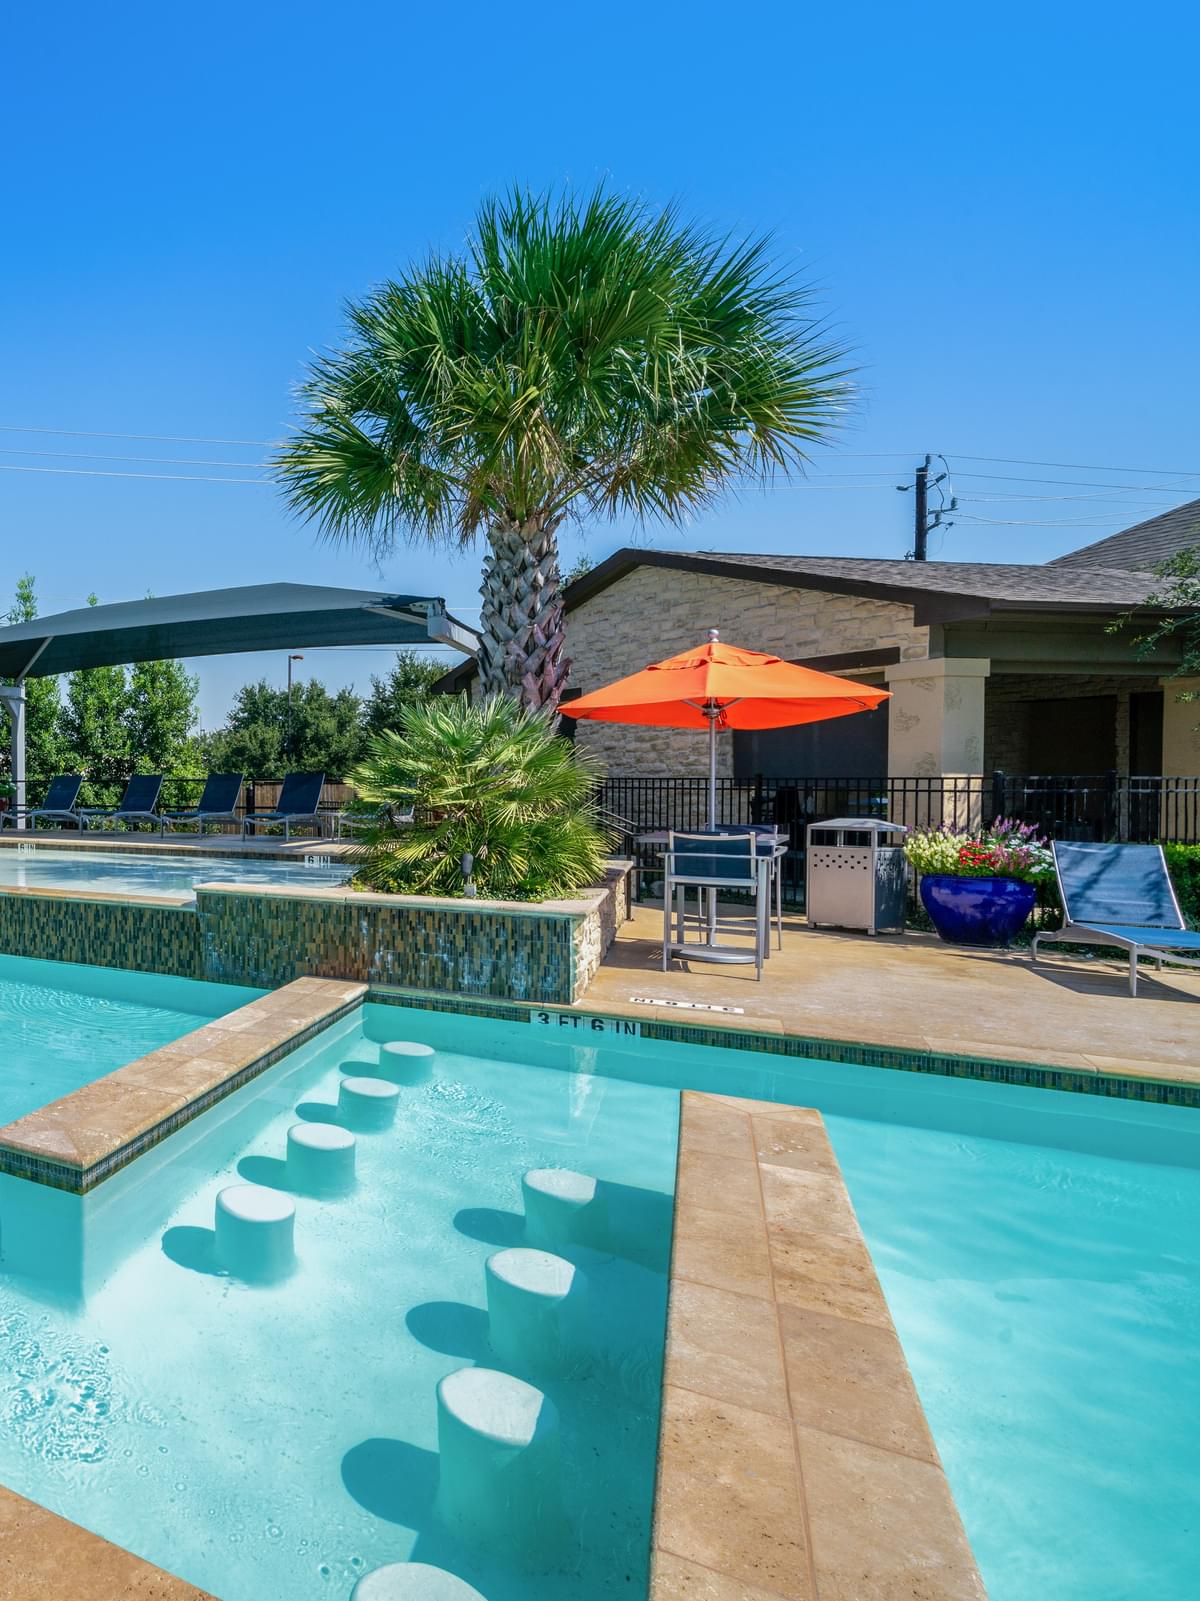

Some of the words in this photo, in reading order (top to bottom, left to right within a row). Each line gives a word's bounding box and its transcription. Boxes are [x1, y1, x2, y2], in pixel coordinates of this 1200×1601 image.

[308, 855, 314, 865] 6
[318, 855, 329, 865] IN
[537, 1012, 550, 1025] 3
[559, 1014, 582, 1029] FT
[591, 1018, 605, 1032] 6
[615, 1021, 636, 1036] IN
